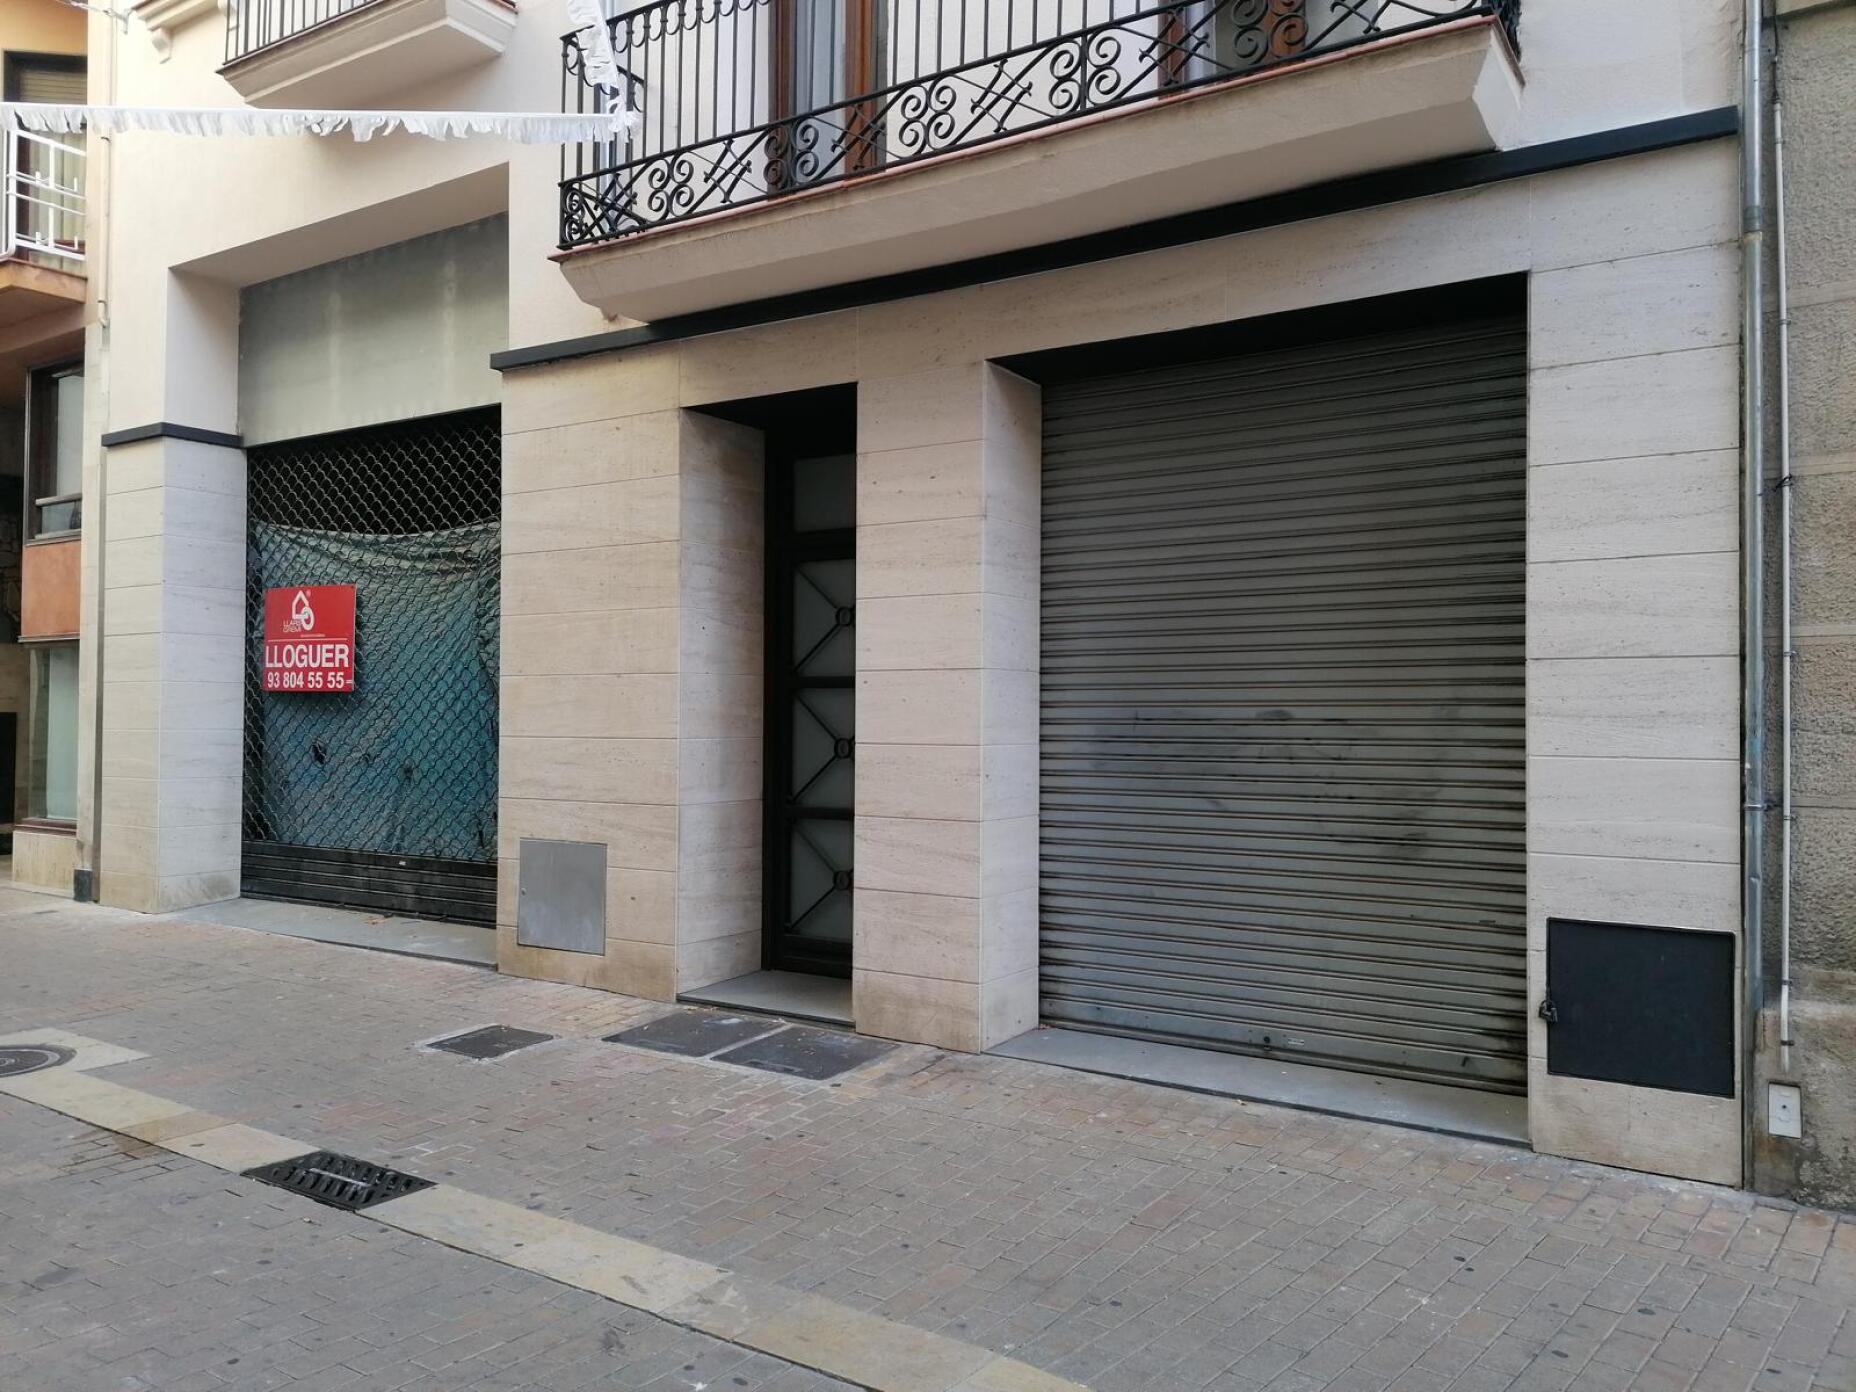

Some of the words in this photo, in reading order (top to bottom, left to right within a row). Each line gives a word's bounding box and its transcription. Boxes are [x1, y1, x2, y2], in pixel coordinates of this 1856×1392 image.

[266, 644, 349, 668] LLOGUER
[267, 672, 280, 689] 93
[283, 672, 304, 689] 804
[307, 672, 323, 689] 55
[327, 671, 344, 689] 55
